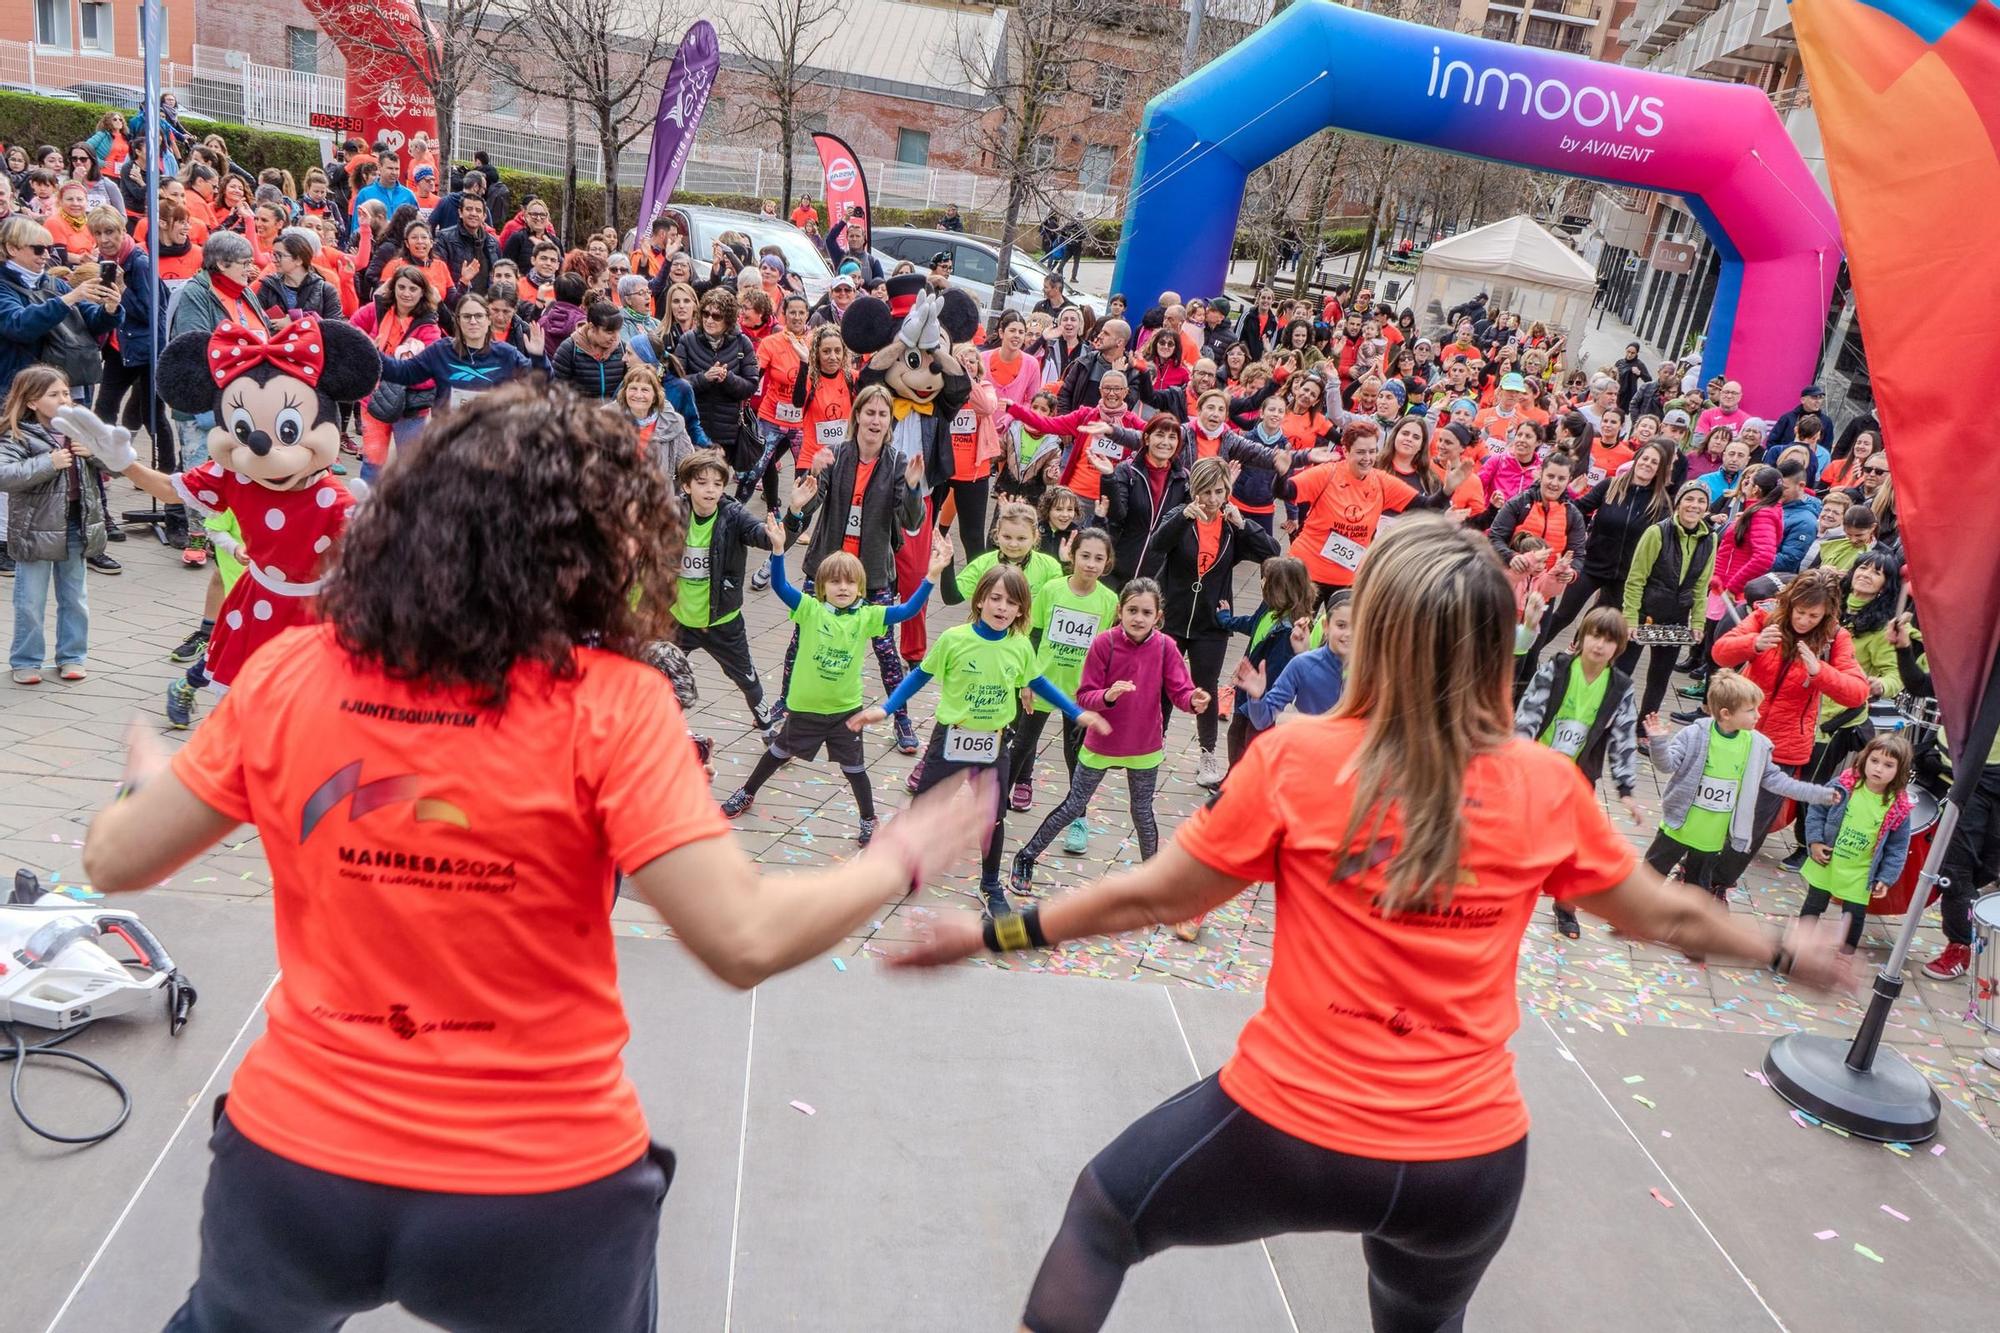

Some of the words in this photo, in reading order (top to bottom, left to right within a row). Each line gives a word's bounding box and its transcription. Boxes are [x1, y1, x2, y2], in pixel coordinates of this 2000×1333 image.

[1427, 45, 1664, 137] inmoovs
[409, 107, 419, 116] de
[311, 113, 362, 131] 00:29:38
[1559, 135, 1580, 153] by
[1582, 141, 1654, 163] AVINENT
[783, 409, 801, 418] 115
[823, 426, 843, 438] 998
[1098, 438, 1117, 451] 675
[1331, 543, 1355, 561] 253
[683, 556, 711, 569] 068
[1057, 619, 1093, 638] 1044
[954, 737, 994, 751] 1056
[1697, 785, 1732, 803] 1021
[338, 846, 517, 878] MANRESA2024
